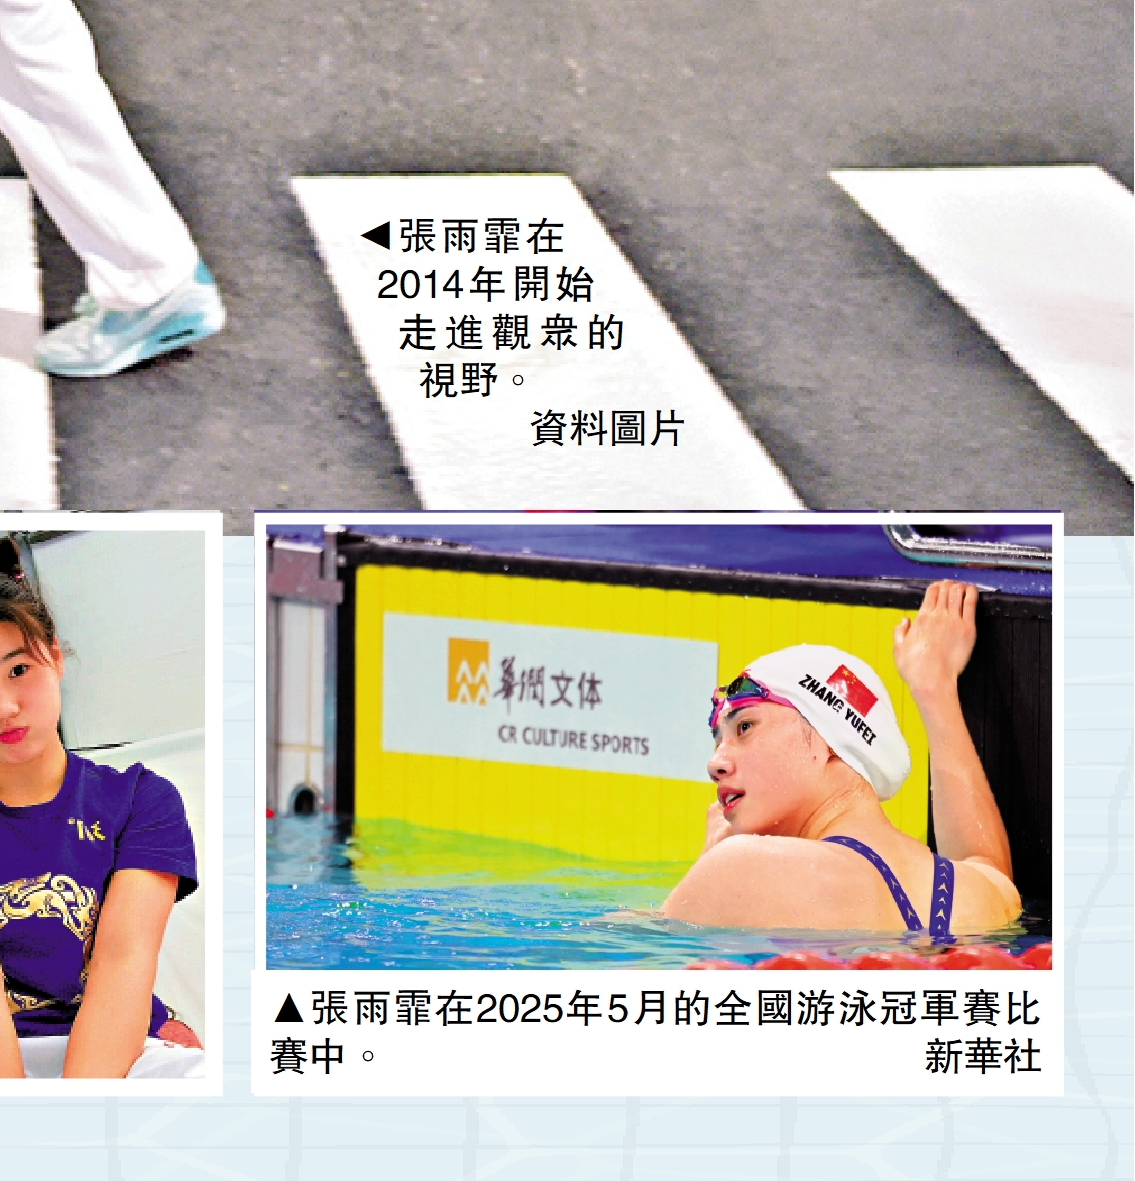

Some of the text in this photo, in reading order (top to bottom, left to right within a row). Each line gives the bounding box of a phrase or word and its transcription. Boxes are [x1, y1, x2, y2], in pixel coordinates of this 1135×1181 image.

[798, 673, 877, 747] ZHANG YUFEI
[498, 724, 650, 756] CR CULTURE SPORTS
